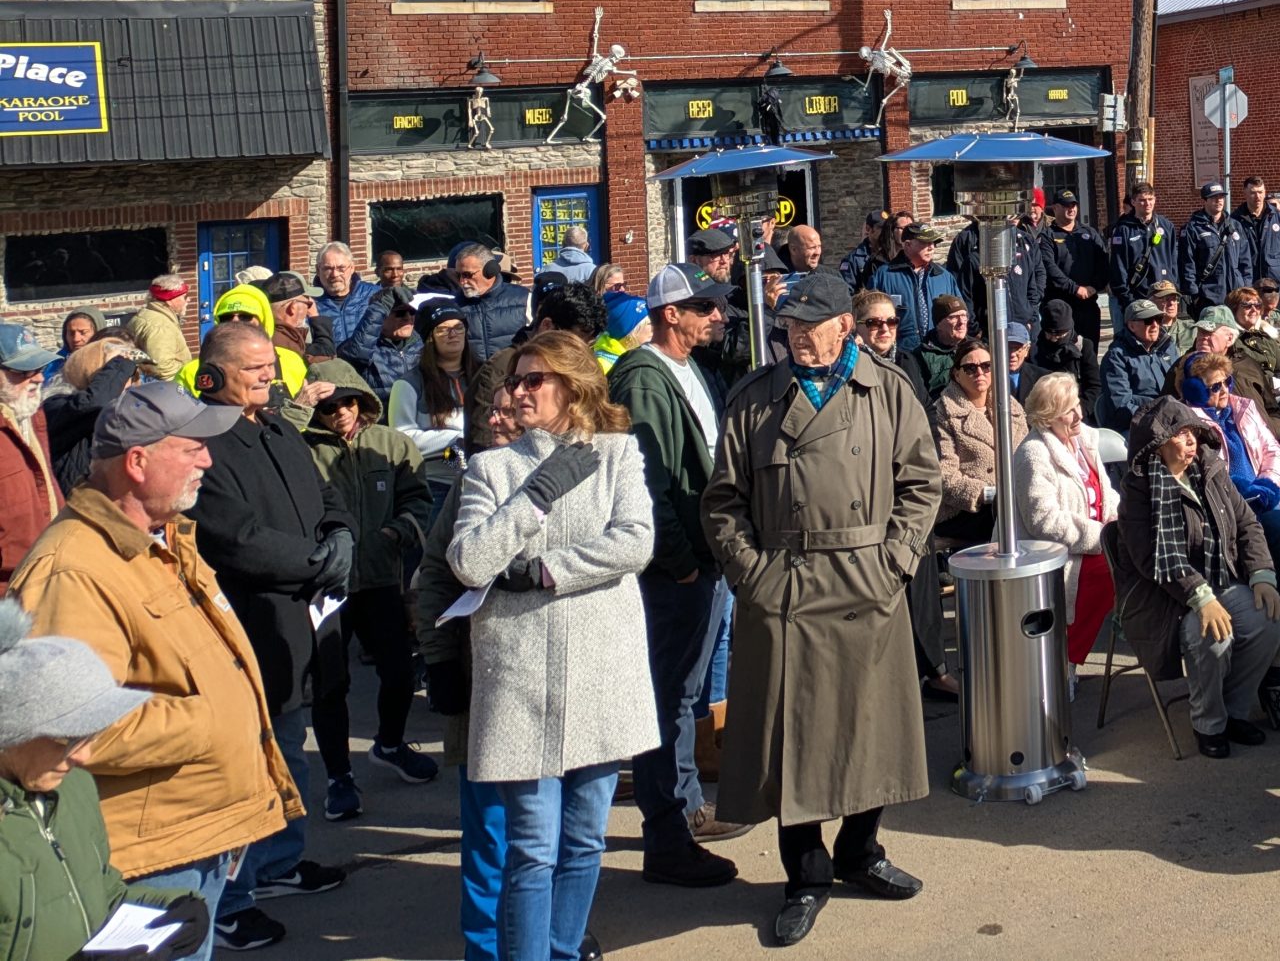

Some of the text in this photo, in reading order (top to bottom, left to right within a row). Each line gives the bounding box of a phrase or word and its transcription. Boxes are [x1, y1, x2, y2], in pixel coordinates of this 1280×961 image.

[0, 53, 87, 88] Place
[0, 95, 91, 108] KARAOKE
[805, 96, 839, 115] LIQUOR
[949, 89, 970, 106] POOL
[18, 111, 65, 122] POOL
[525, 109, 553, 125] MUSIC
[688, 100, 713, 119] BEER
